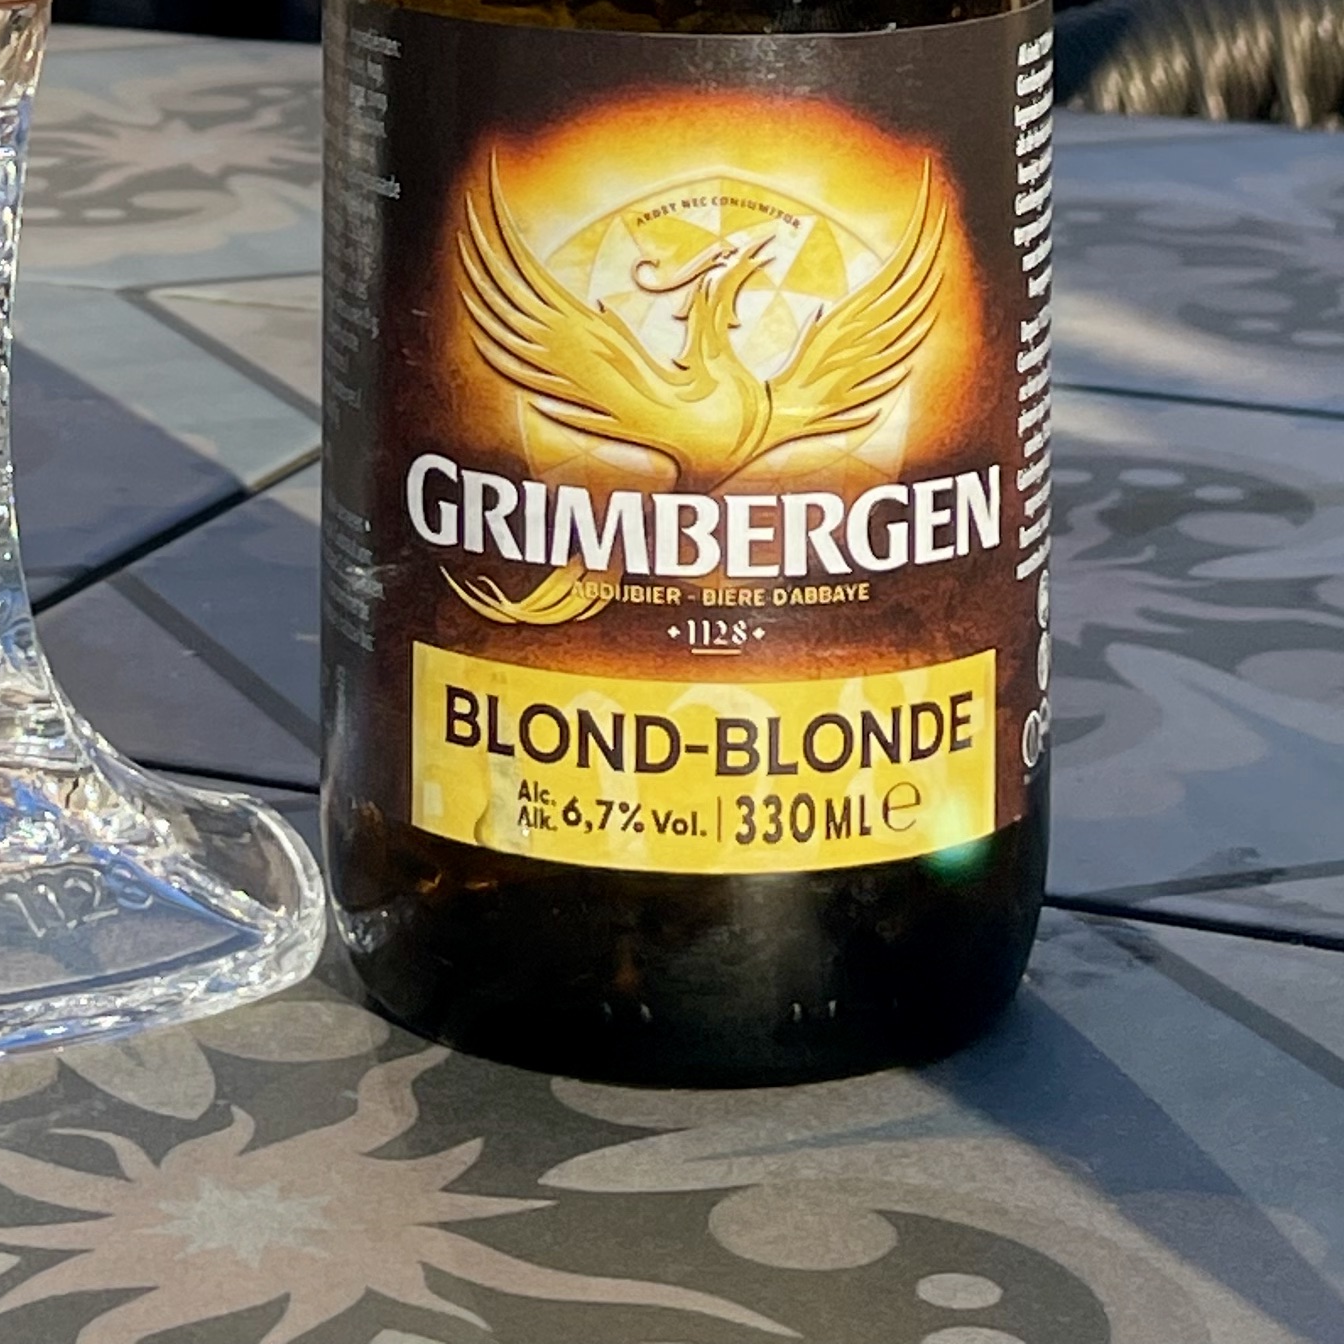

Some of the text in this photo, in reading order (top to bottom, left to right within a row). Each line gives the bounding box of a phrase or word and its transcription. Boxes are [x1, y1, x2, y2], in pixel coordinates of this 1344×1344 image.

[406, 452, 1001, 579] GRIMBERGEN
[773, 582, 871, 607] D'ABBAYE
[686, 618, 748, 647] 1128
[444, 683, 974, 777] BLOND-BLONDE
[517, 779, 557, 807] Alc.
[517, 805, 559, 831] Alk.
[561, 796, 646, 834] 6,7%
[651, 809, 708, 837] Vol.
